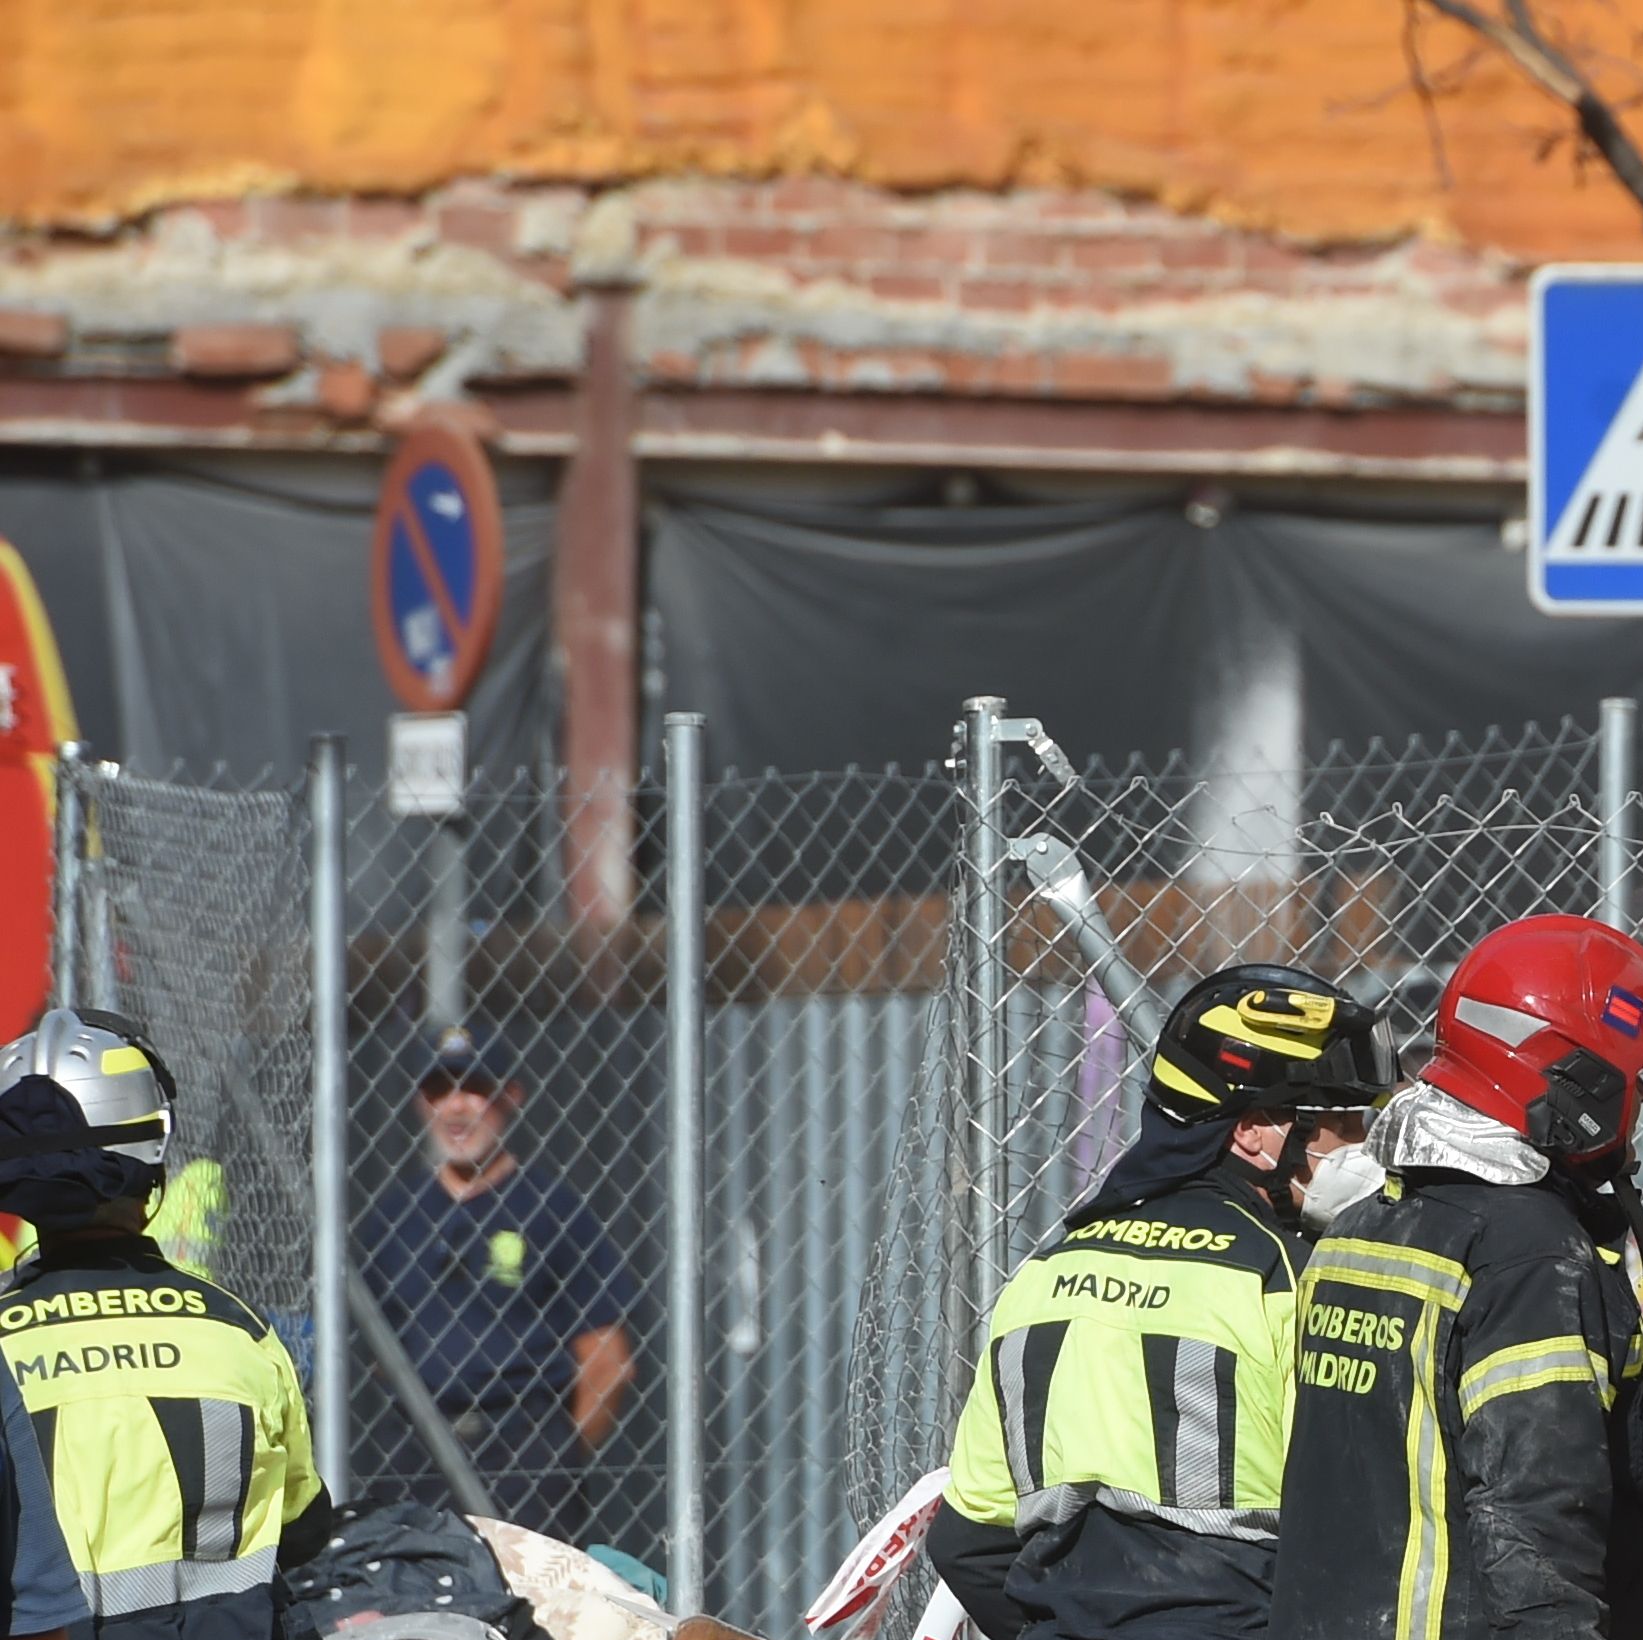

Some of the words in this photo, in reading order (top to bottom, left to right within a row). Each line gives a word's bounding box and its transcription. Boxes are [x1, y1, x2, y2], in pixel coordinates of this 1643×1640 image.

[1051, 1273, 1172, 1311] MADRID
[1306, 1301, 1406, 1352] OMBEROS
[14, 1342, 182, 1387] MADRID
